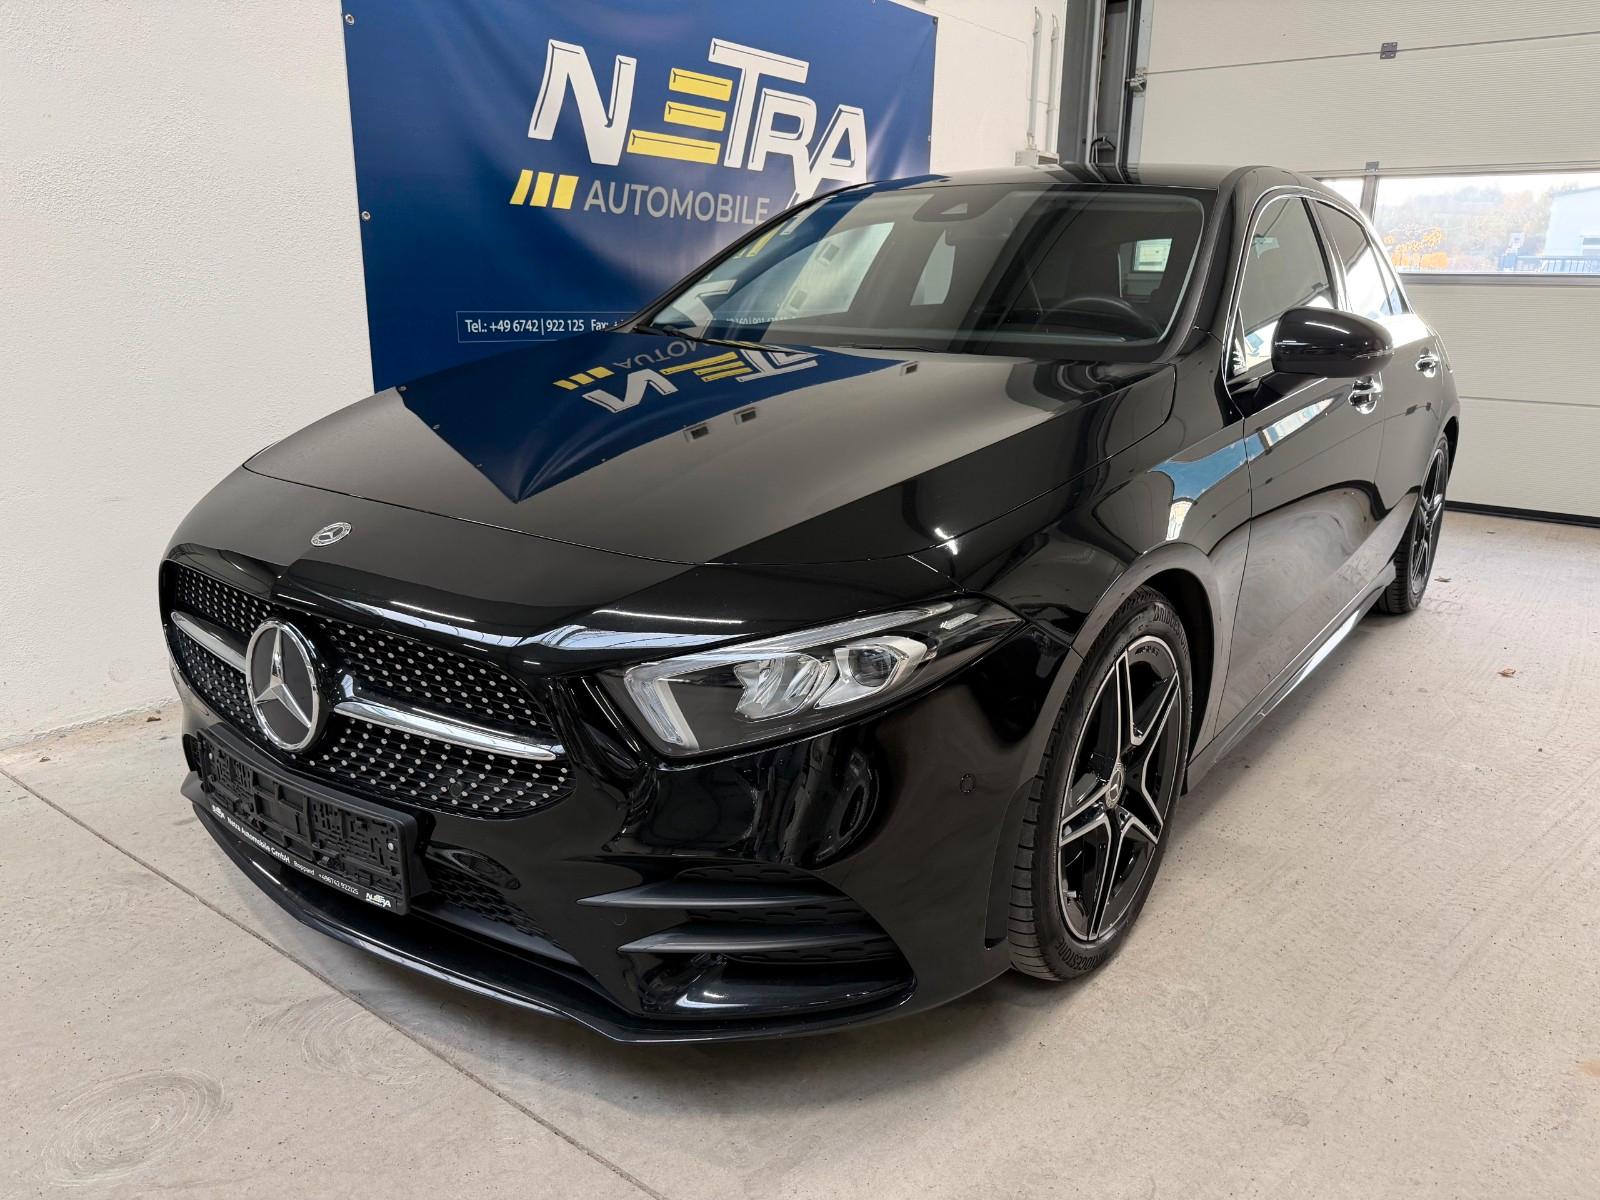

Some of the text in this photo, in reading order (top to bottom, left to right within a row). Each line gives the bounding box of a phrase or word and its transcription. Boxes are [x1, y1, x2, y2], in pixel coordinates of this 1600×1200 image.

[528, 38, 867, 209] NETRA
[583, 179, 770, 225] AUTOMOBILE
[465, 319, 488, 333] Tel.:
[489, 319, 511, 333] +49
[568, 319, 585, 332] 125
